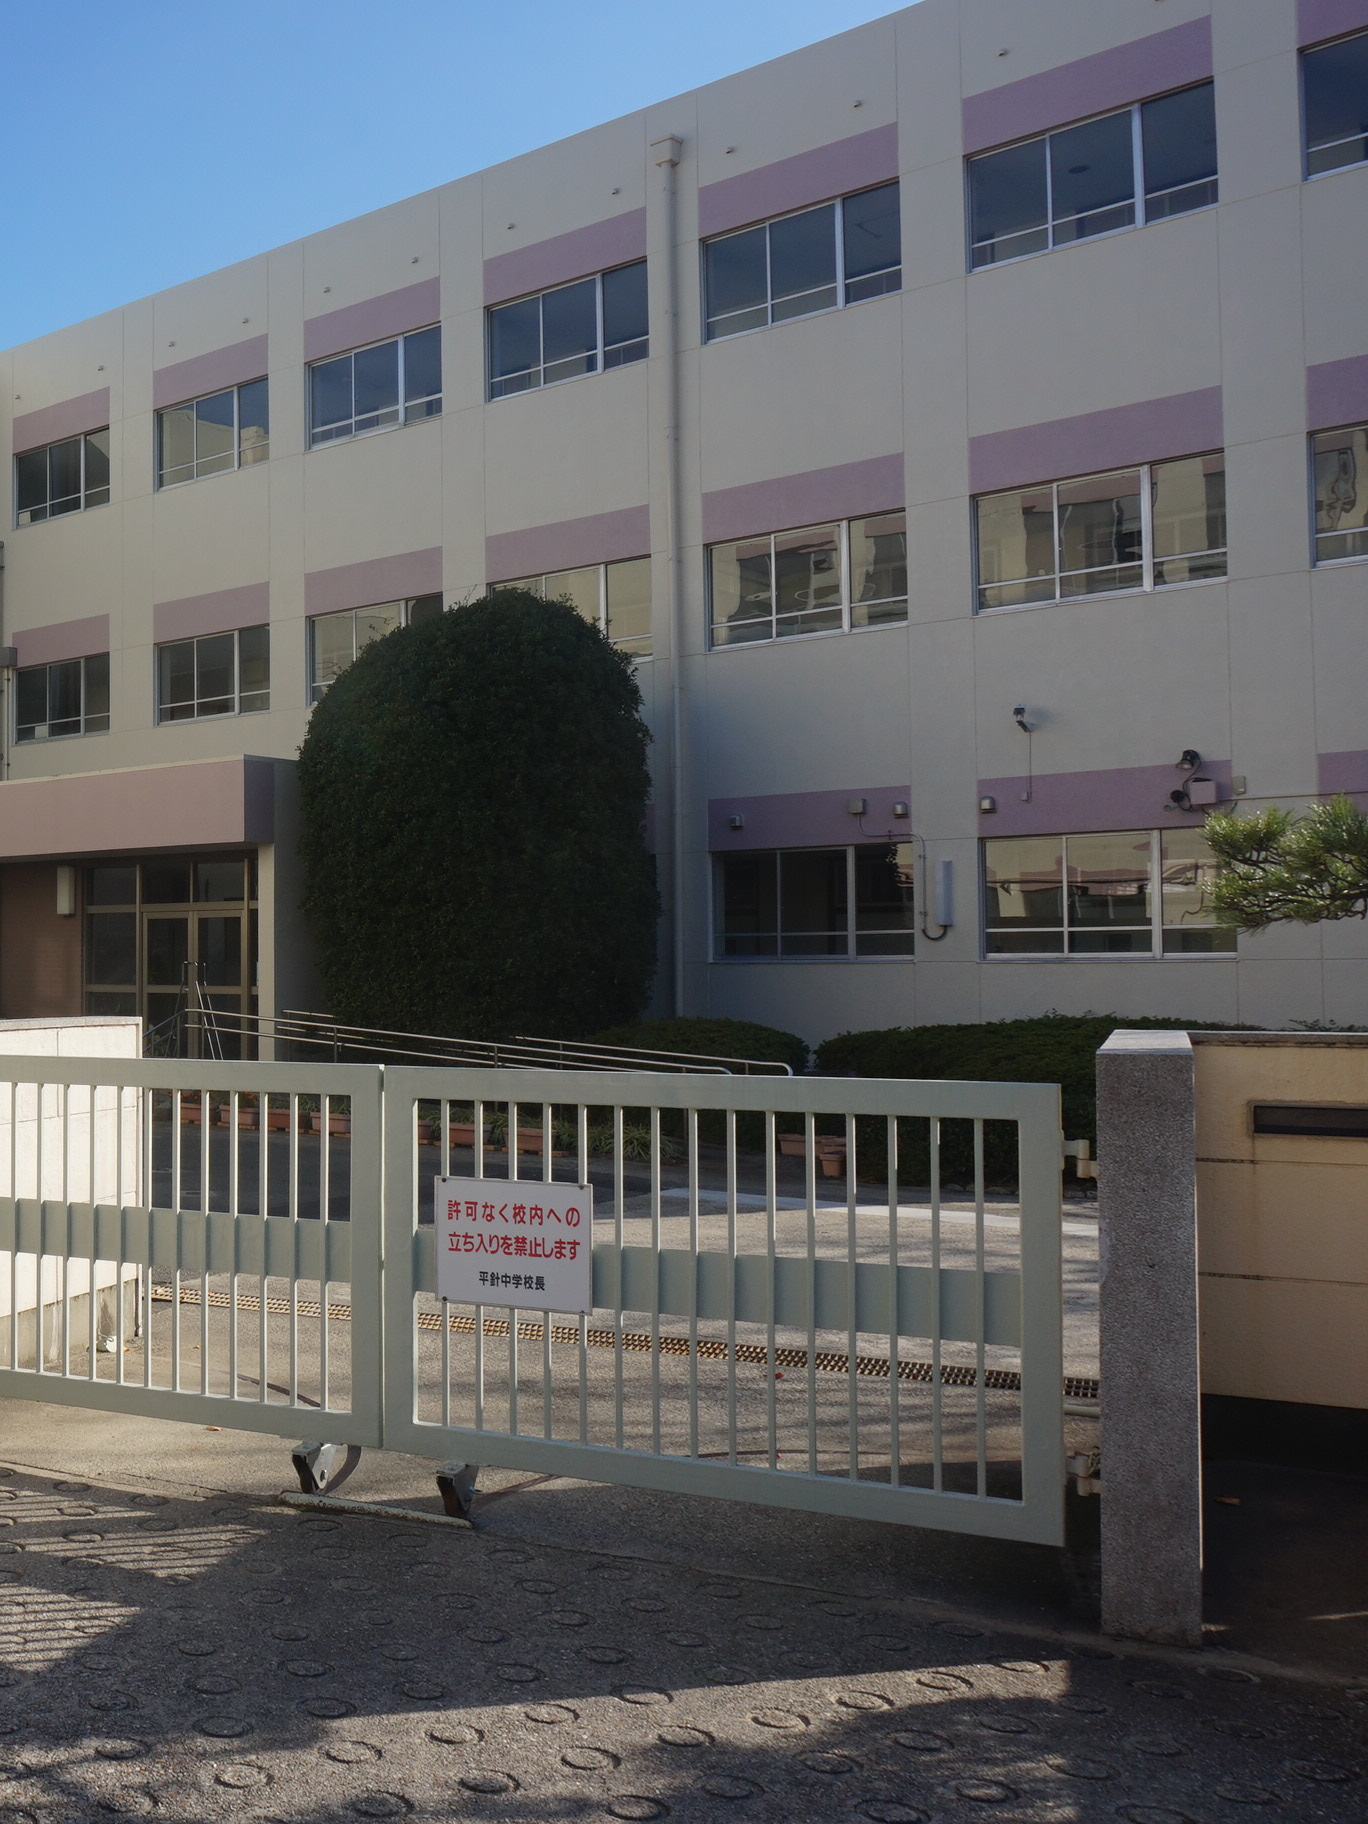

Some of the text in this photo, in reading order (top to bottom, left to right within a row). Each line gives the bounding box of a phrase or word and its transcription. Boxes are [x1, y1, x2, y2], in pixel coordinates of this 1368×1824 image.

[447, 1200, 581, 1227] 許可なく校内への
[448, 1232, 581, 1260] 立ち入りを禁止します
[478, 1271, 546, 1291] 平針中学校長
